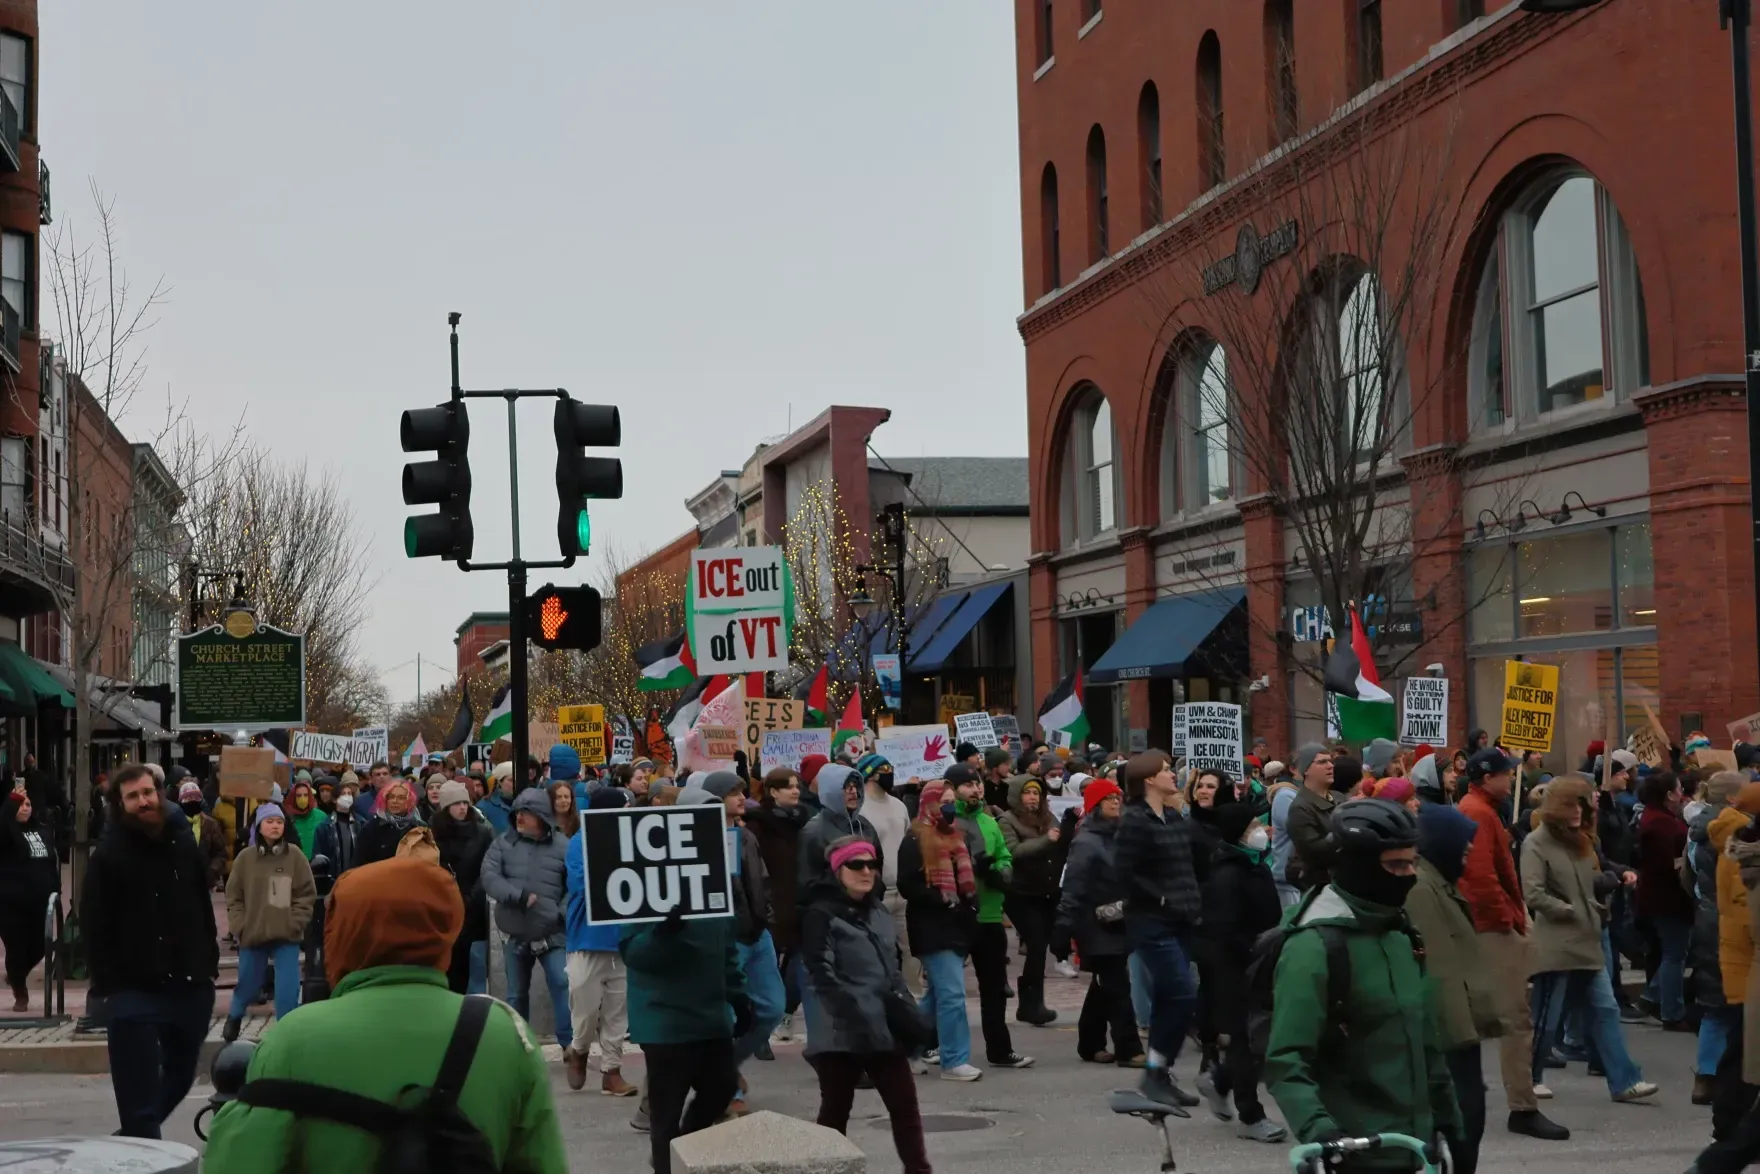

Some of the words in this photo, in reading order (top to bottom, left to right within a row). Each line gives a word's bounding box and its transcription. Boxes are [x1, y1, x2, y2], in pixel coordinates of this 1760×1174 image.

[697, 558, 744, 599] ICE
[745, 561, 780, 593] out
[710, 619, 737, 662] of
[738, 616, 781, 660] VT
[190, 645, 240, 654] CHURCH
[247, 643, 294, 653] STREET
[196, 653, 285, 663] MARKETPLACE
[1419, 680, 1444, 692] WHOLE
[1507, 686, 1532, 702] JUSTICE
[1534, 690, 1553, 706] FOR
[1407, 698, 1413, 710] IS
[1414, 698, 1443, 711] GUILTY
[1188, 706, 1205, 717] UVM
[1206, 706, 1217, 717] &
[1217, 706, 1238, 720] CHAMP
[1505, 708, 1520, 725] ALEX
[1521, 710, 1551, 727] PRETTI
[561, 723, 588, 734] JUSTICE
[589, 722, 601, 732] FOR
[958, 721, 969, 729] NO
[970, 719, 990, 727] MASS
[1407, 720, 1441, 737] DOWN!
[1189, 725, 1239, 742] MINNESOTA!
[1505, 724, 1521, 737] KILLED
[1522, 724, 1531, 737] BY
[1532, 726, 1548, 739] CBP
[579, 736, 603, 747] PRETTI
[582, 748, 590, 757] BY
[590, 747, 602, 757] CBP
[1193, 743, 1208, 757] ICE
[1208, 743, 1226, 758] OUT
[1227, 744, 1236, 759] OF
[1189, 758, 1240, 772] EVERYWHERE!
[618, 812, 698, 863] ICE
